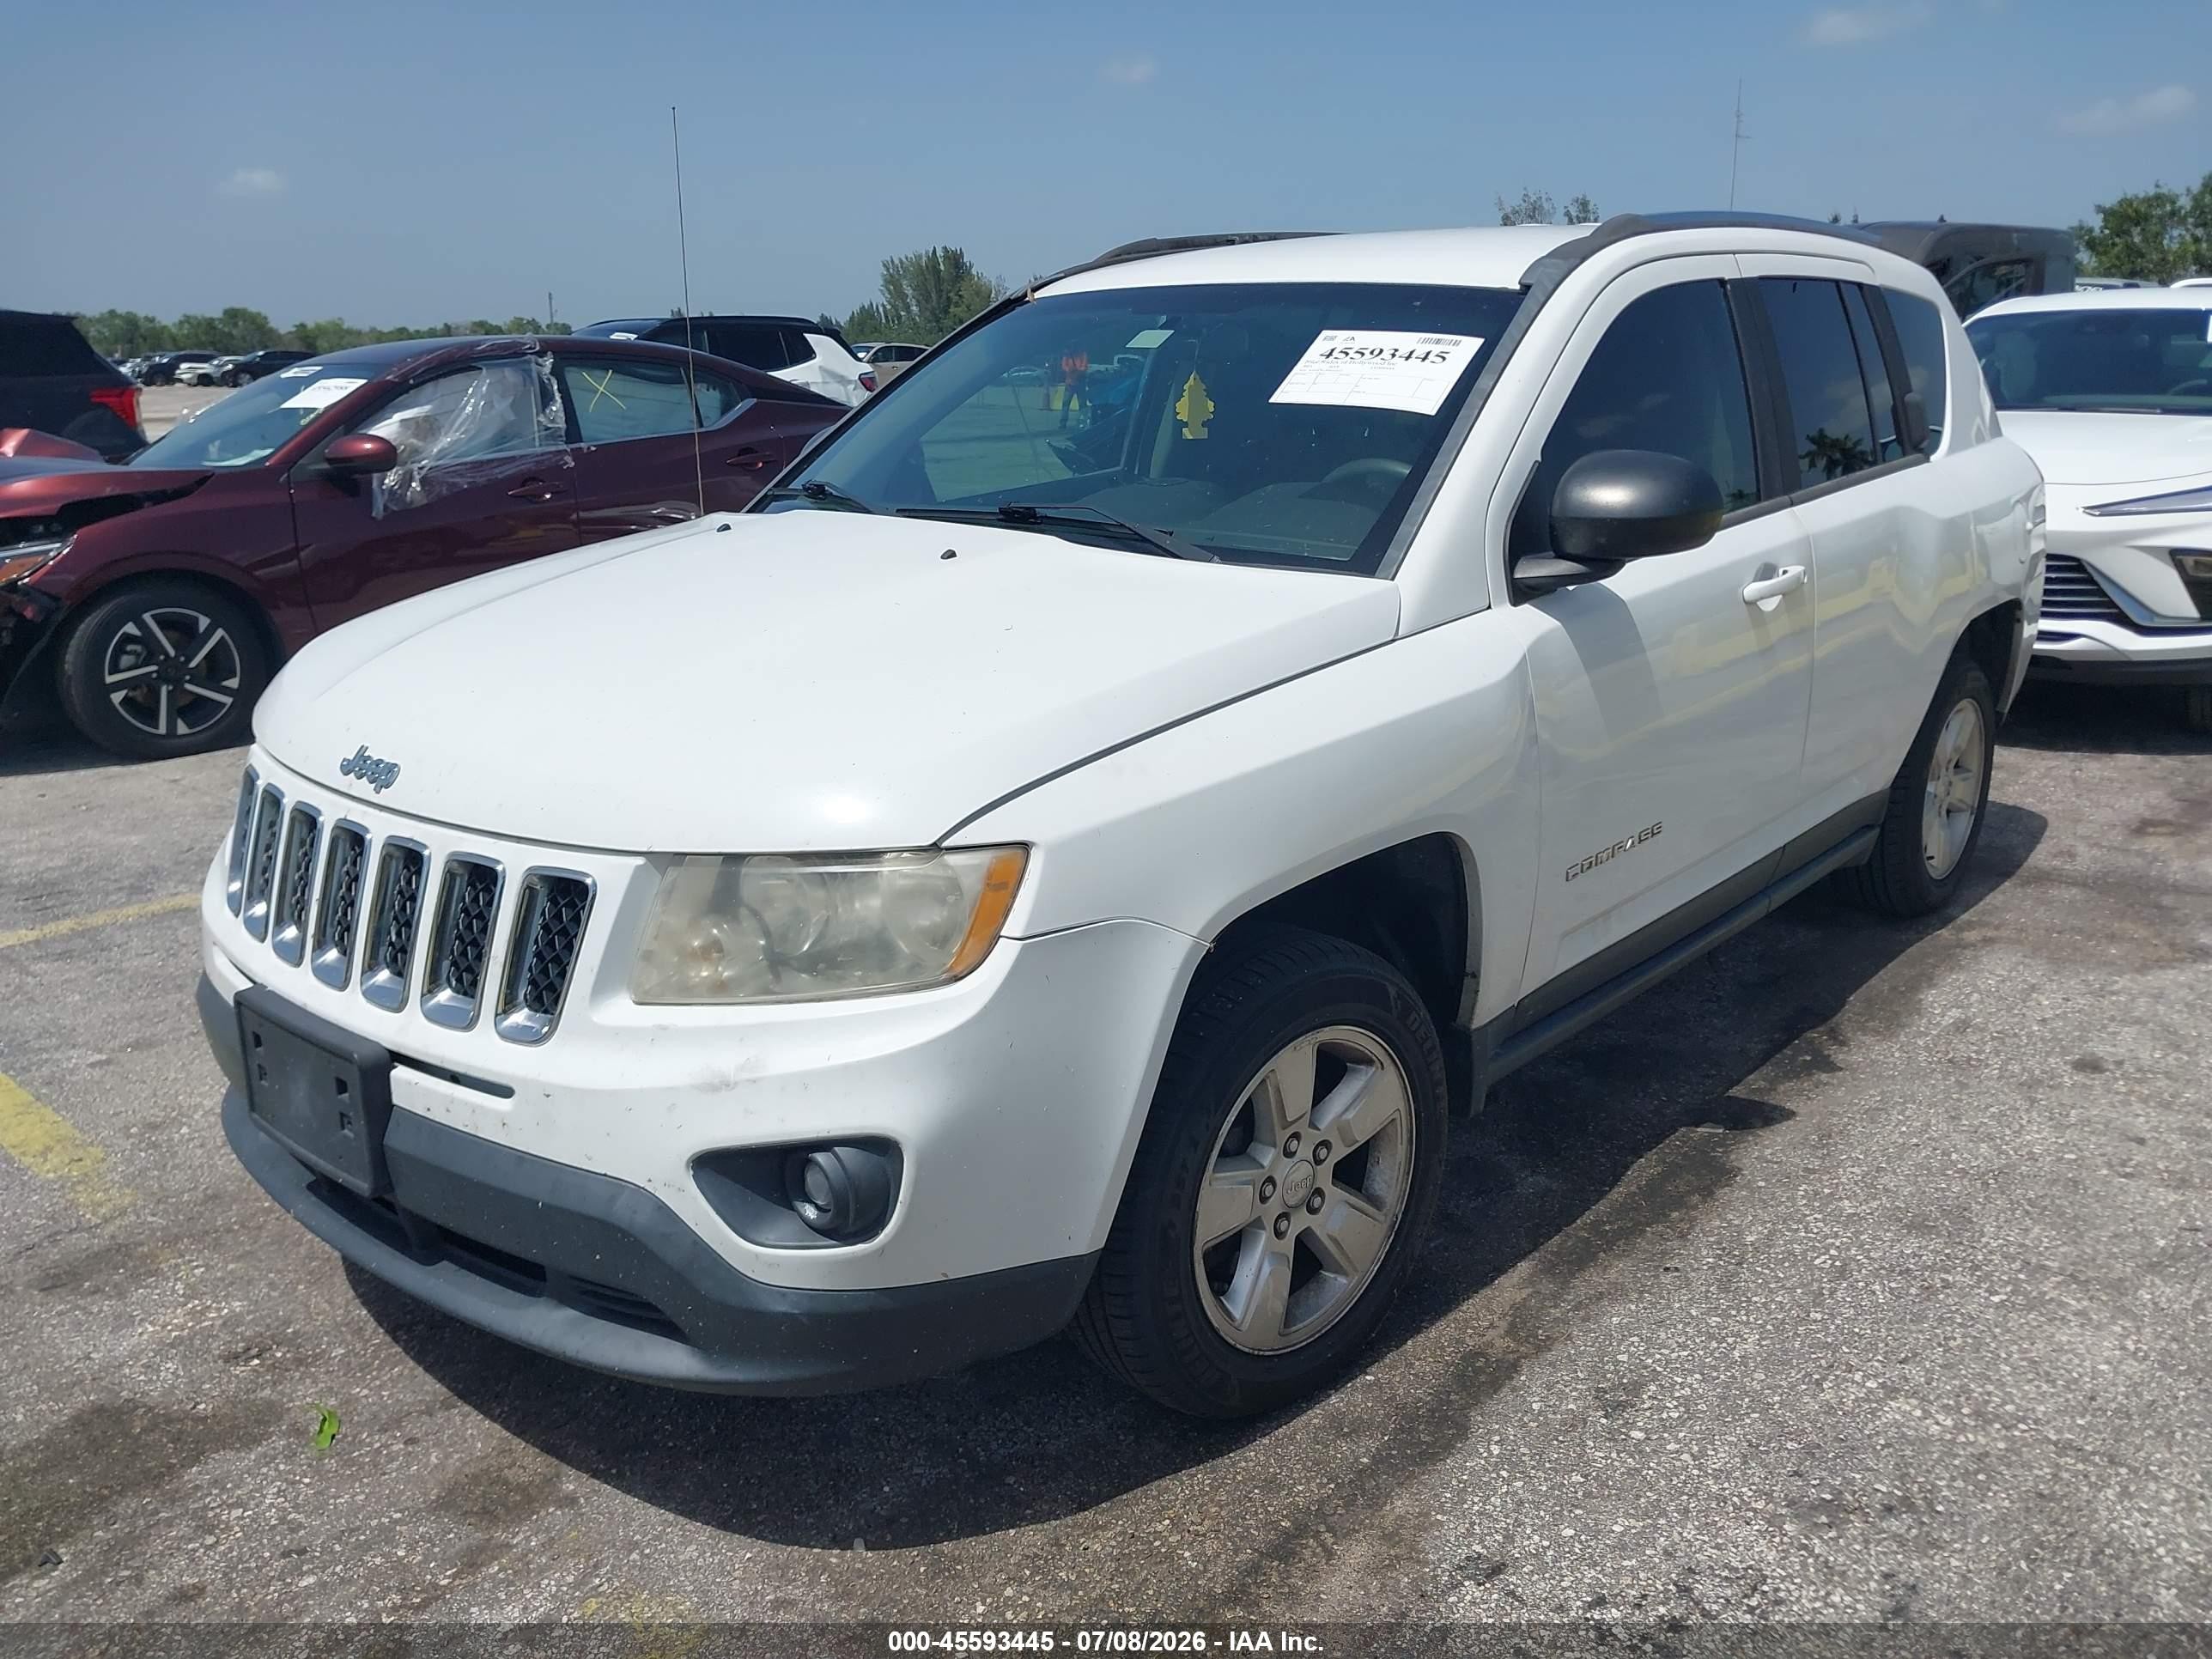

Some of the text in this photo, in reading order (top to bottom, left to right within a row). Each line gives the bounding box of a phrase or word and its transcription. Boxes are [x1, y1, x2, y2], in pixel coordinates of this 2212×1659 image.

[1319, 346, 1450, 364] 45593445
[340, 744, 400, 794] Jeep
[1566, 821, 1662, 882] COMPASS
[1285, 1174, 1313, 1194] Jeep
